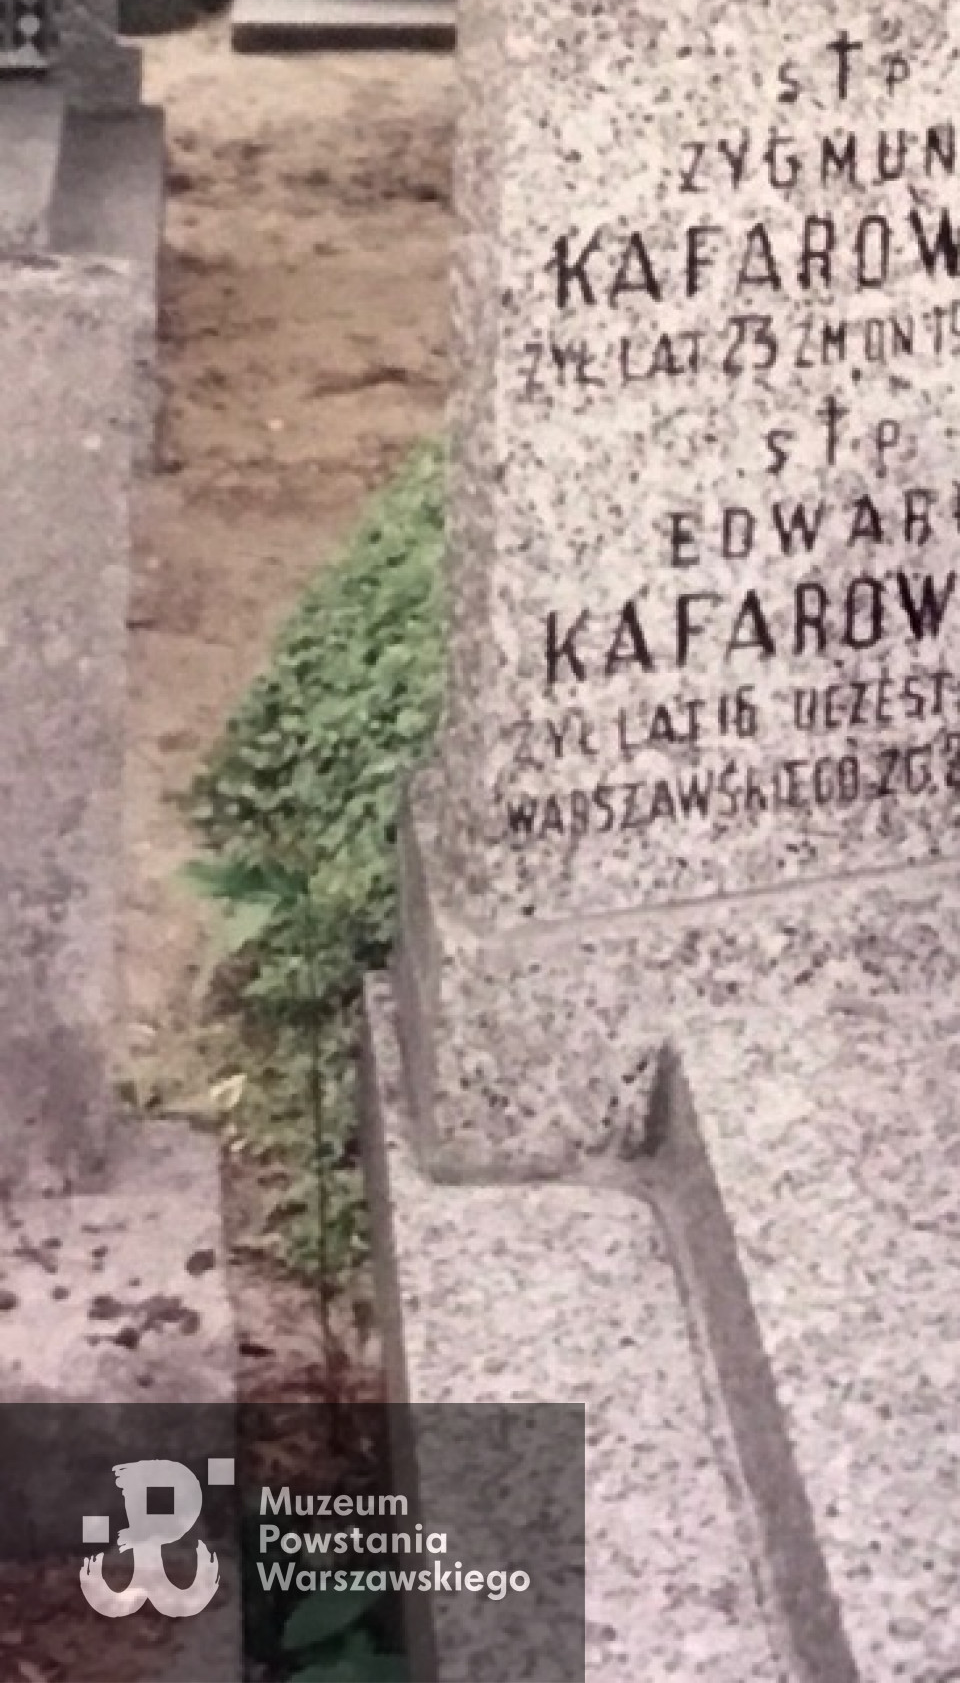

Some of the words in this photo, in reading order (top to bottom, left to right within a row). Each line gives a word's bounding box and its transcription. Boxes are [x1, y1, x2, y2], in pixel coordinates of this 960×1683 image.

[619, 329, 706, 386] LAT
[721, 314, 777, 377] 23
[615, 698, 705, 756] LAT
[717, 683, 758, 737] 16
[507, 754, 862, 835] WARSZAWSKIEGO
